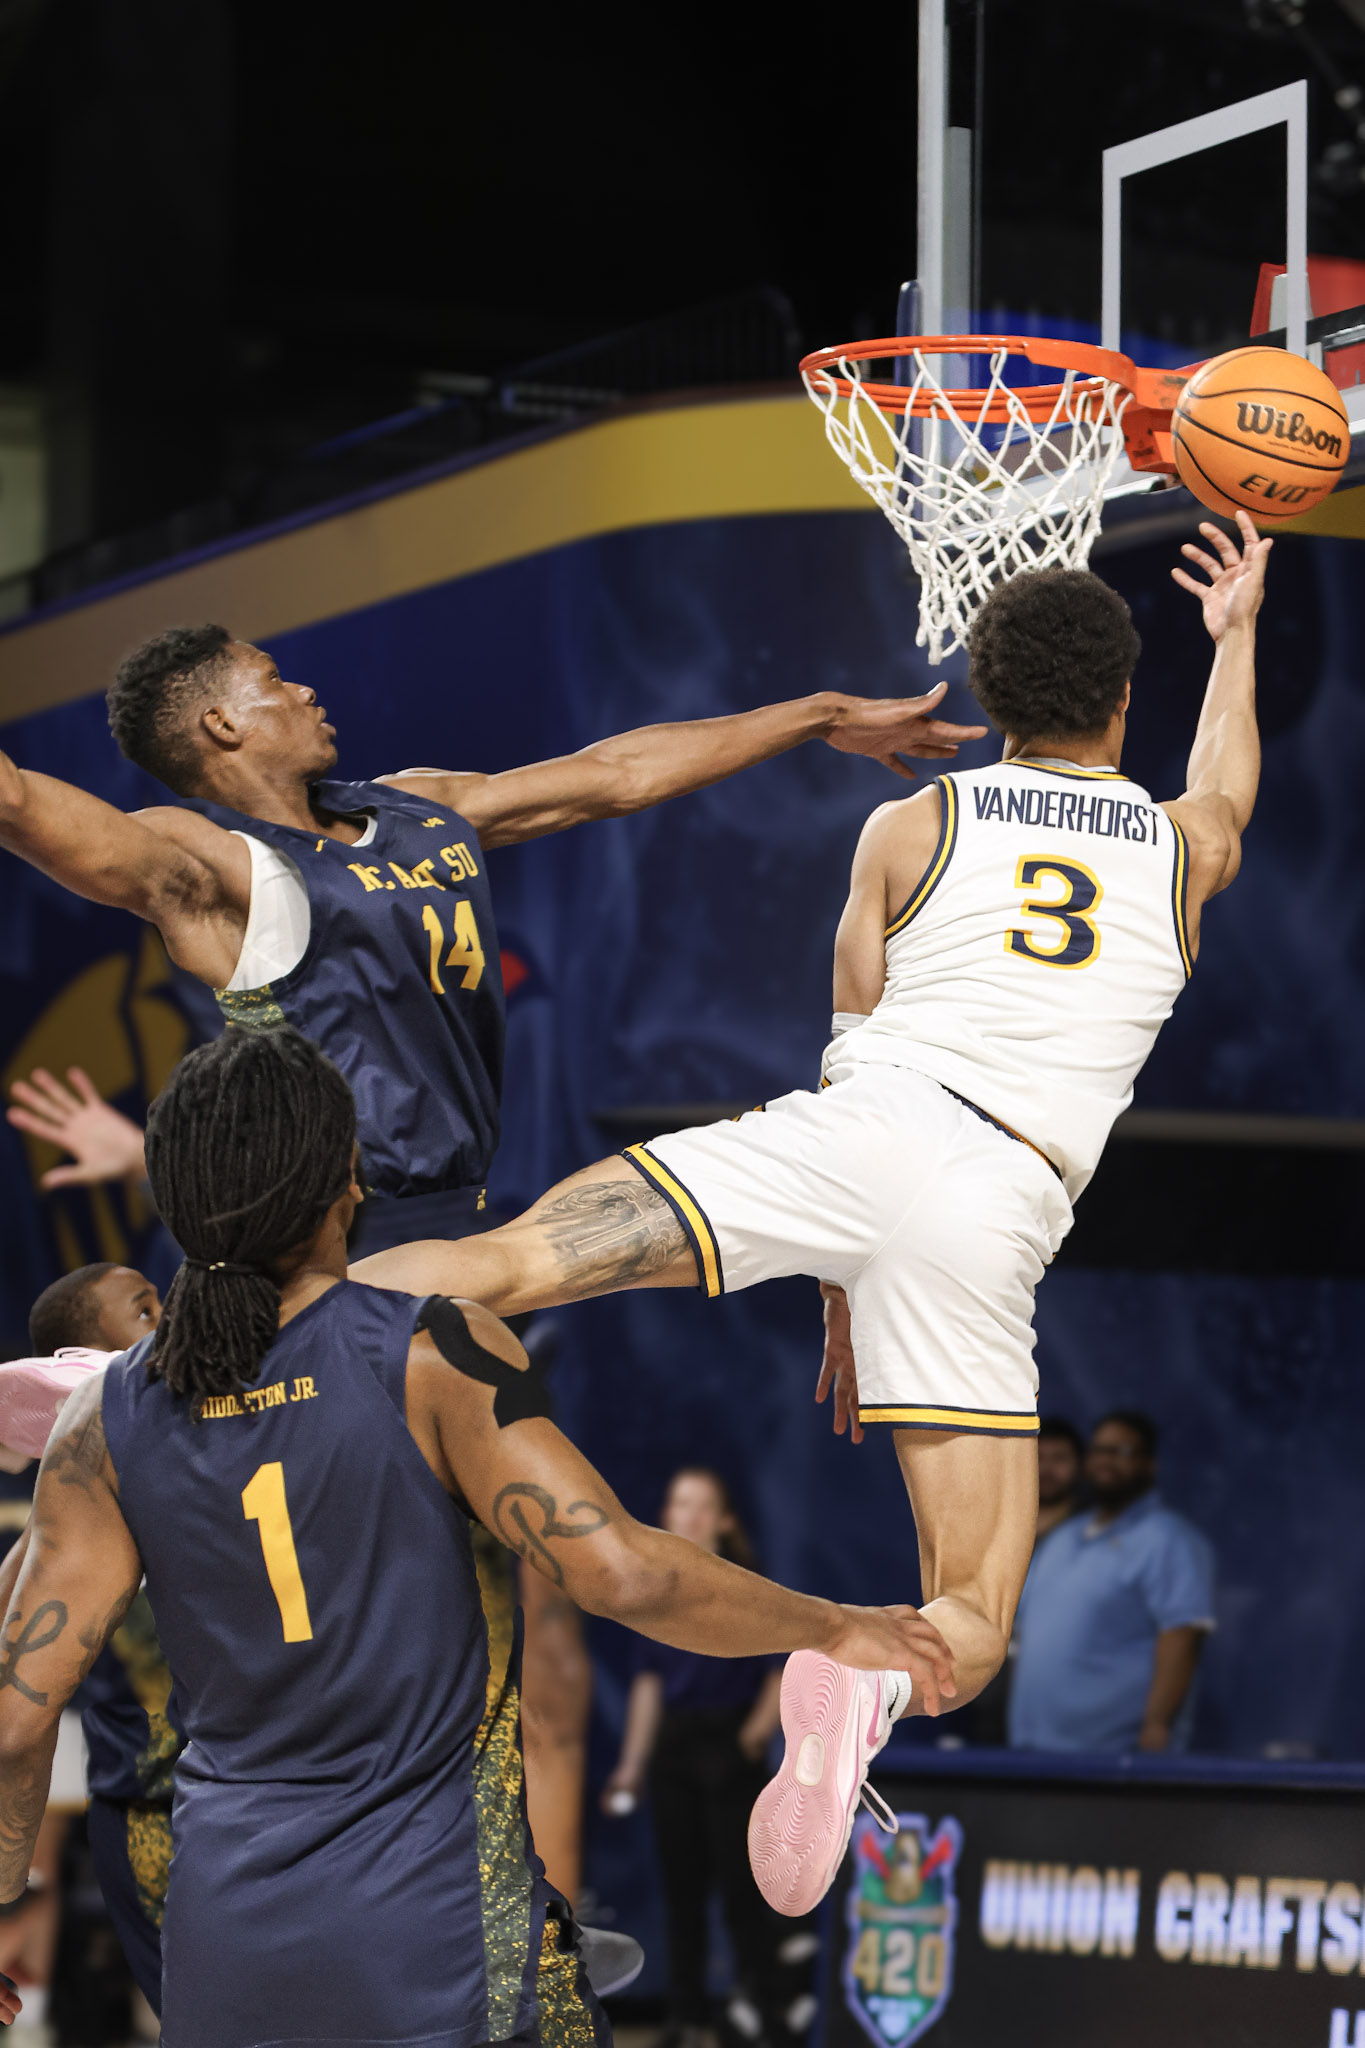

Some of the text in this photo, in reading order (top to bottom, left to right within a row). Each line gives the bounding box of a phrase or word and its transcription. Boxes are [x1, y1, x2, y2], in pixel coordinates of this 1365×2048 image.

[1236, 401, 1342, 459] Wilson
[1239, 473, 1309, 503] EVO
[973, 786, 1158, 846] VANDERHORST
[440, 842, 479, 882] SU
[1003, 853, 1104, 970] 3
[422, 900, 486, 994] 14
[241, 1461, 313, 1643] 1
[979, 1859, 1365, 1977] UNION CRAFTS
[853, 1928, 946, 1997] 420
